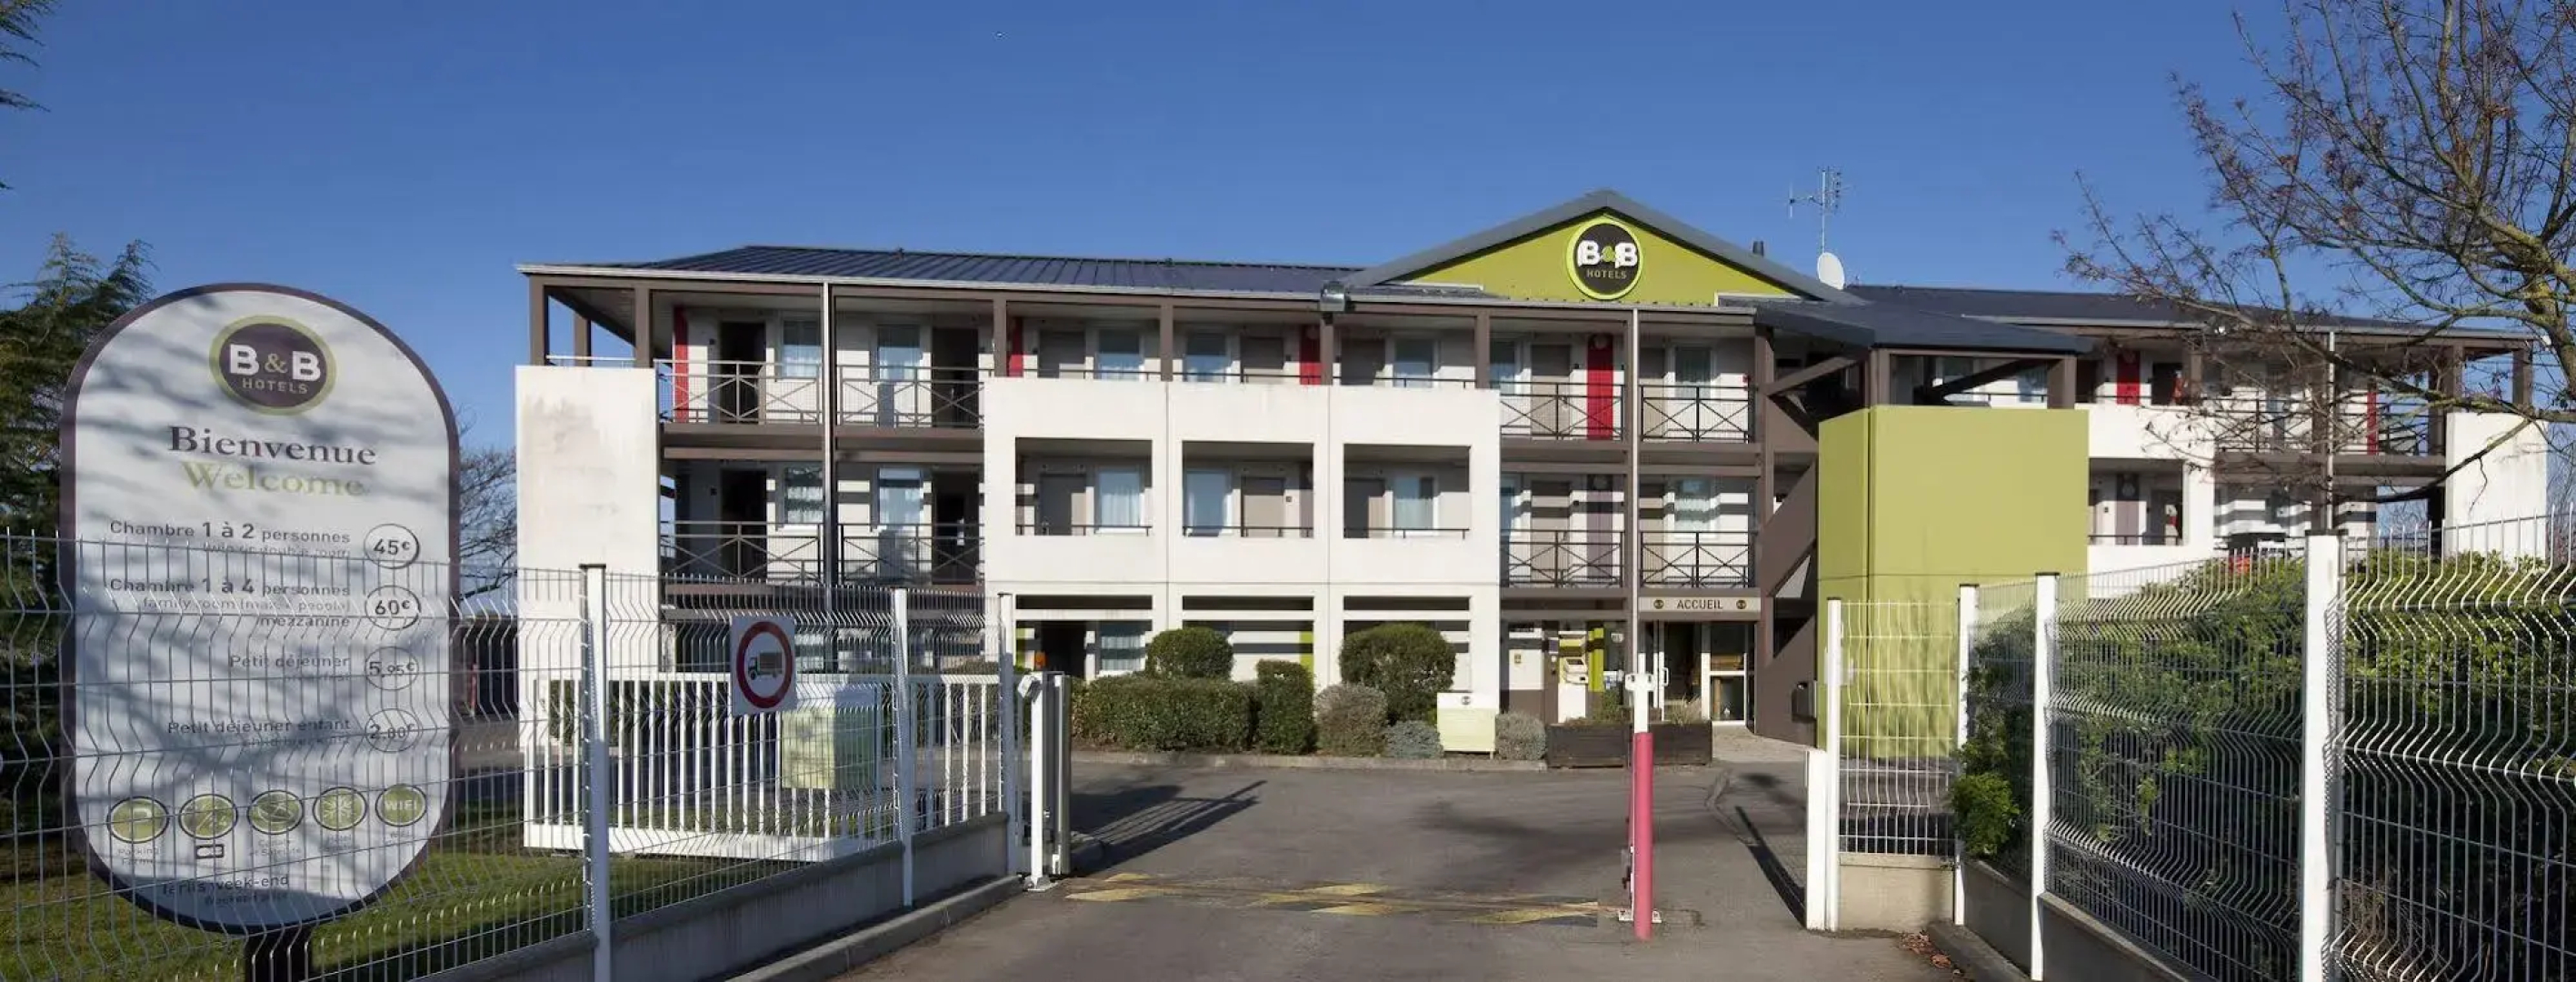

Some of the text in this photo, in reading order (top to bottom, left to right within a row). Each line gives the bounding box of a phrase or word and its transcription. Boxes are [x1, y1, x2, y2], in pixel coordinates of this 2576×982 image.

[1586, 269, 1627, 279] HOTELS
[242, 377, 309, 395] HOTELS
[167, 426, 376, 466] Bienvenue
[181, 460, 366, 497] Welcome
[110, 520, 195, 536] Chambre
[202, 522, 211, 537] 1
[221, 521, 234, 537] à
[242, 523, 255, 539] 2
[262, 529, 351, 544] personnes
[110, 578, 195, 592] Chambre
[202, 578, 211, 593] 1
[1676, 599, 1724, 610] ACCUEIL
